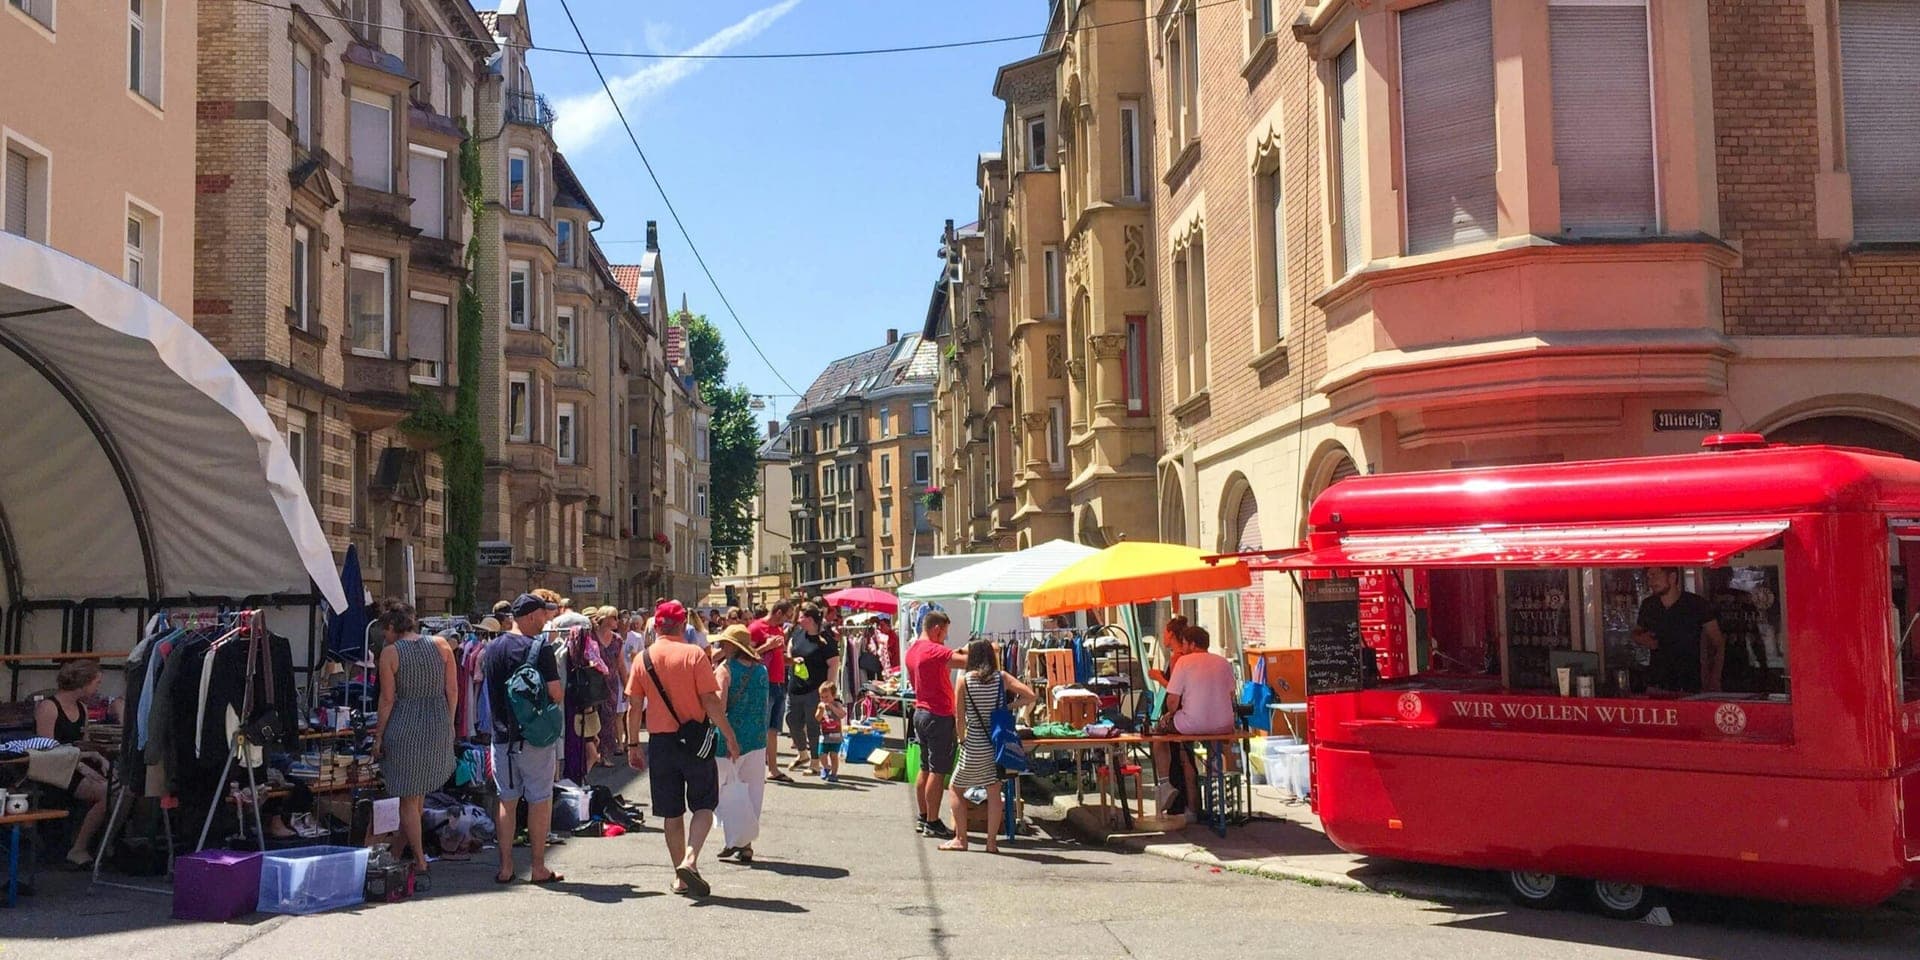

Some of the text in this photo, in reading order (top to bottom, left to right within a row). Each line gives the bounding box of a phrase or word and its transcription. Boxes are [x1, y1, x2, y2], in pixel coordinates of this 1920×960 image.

[1452, 701, 1679, 726] WIR WOLLEN WULLE
